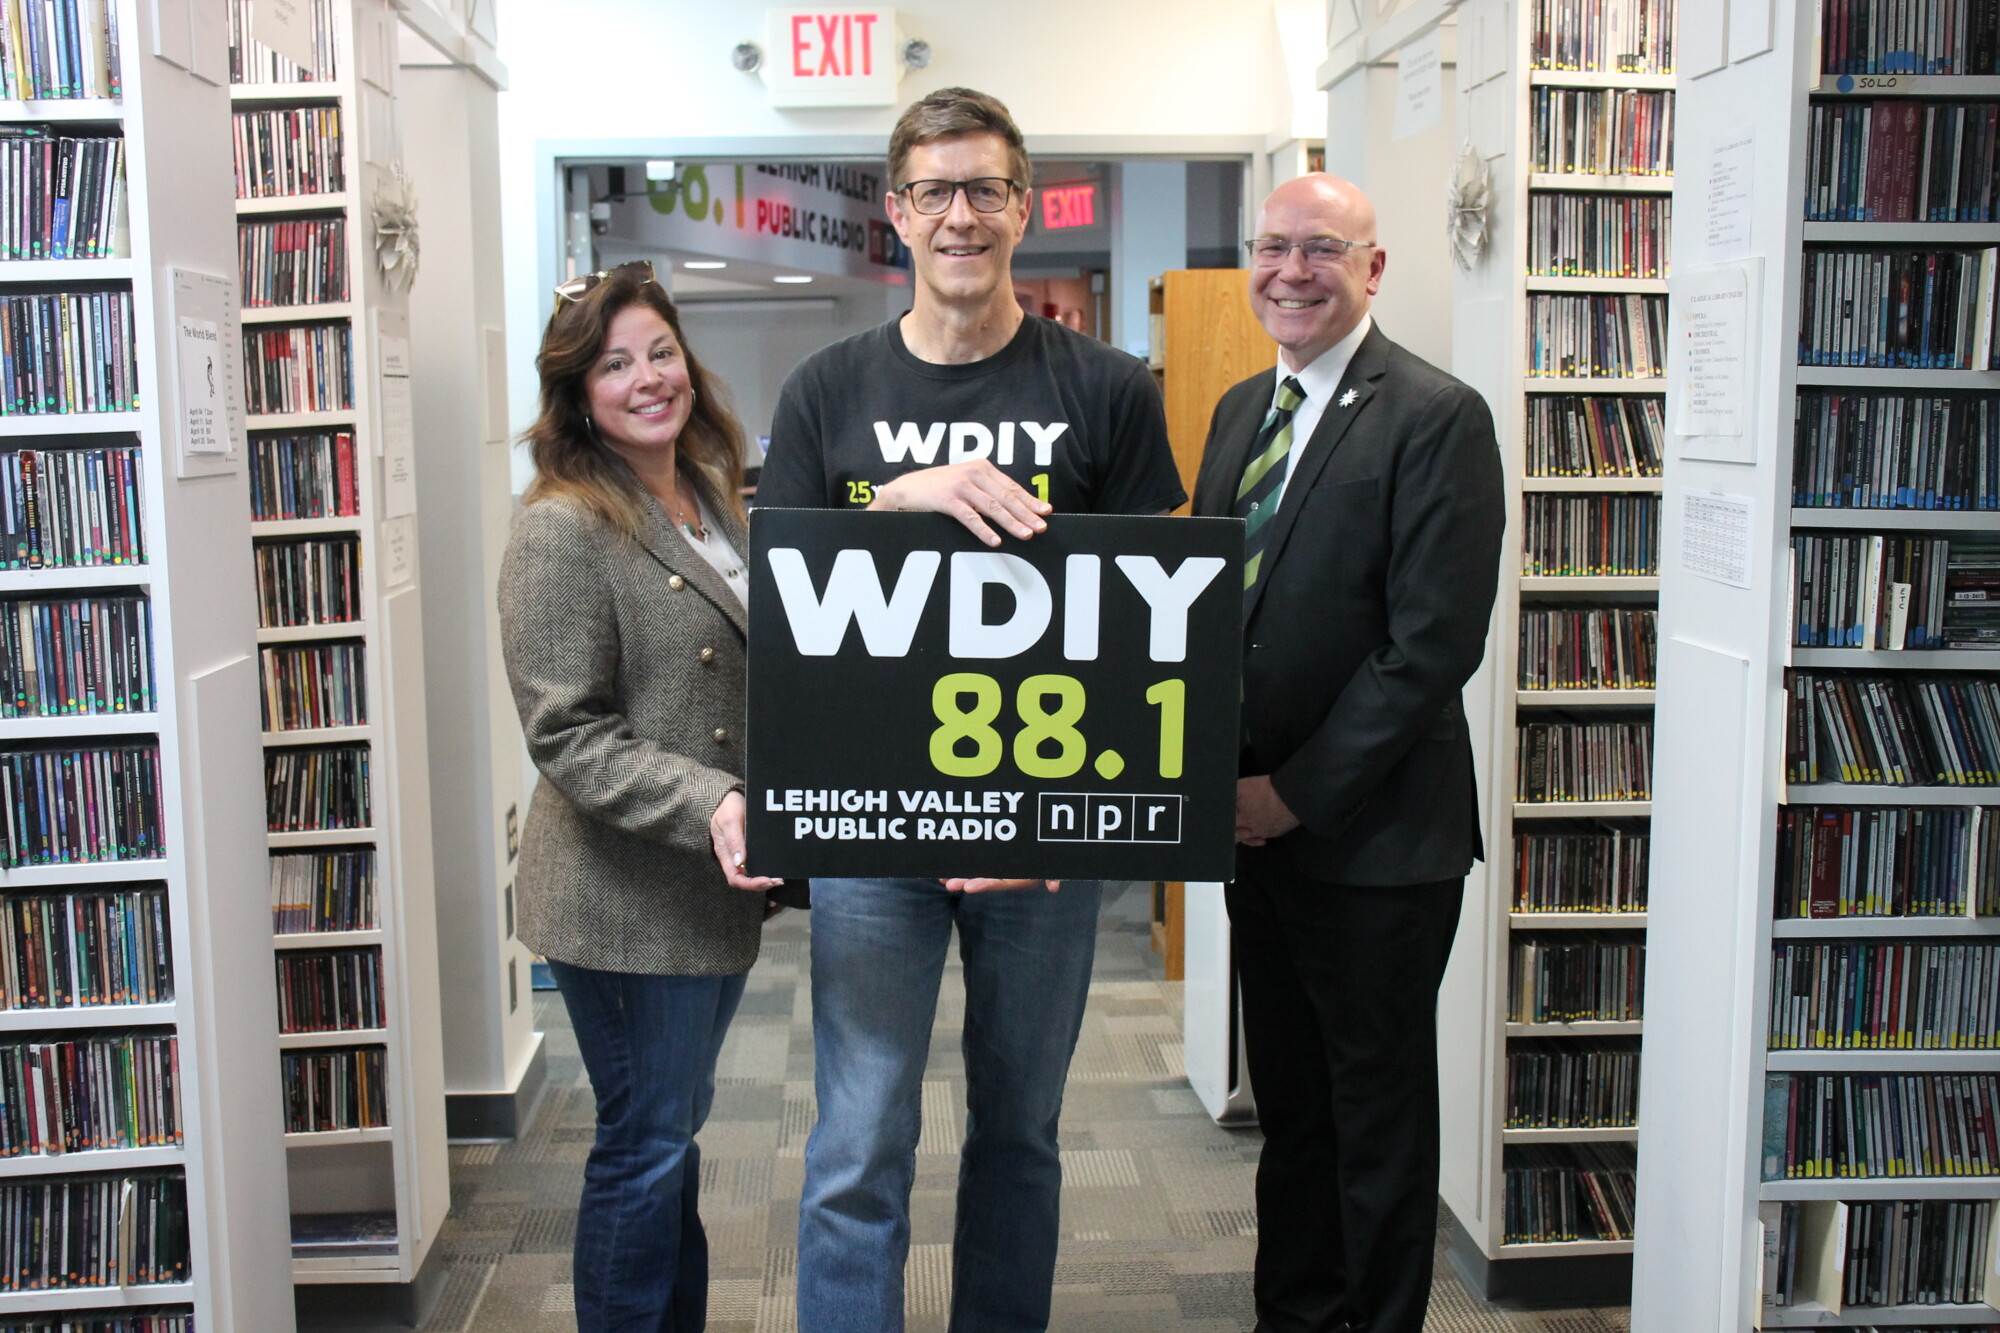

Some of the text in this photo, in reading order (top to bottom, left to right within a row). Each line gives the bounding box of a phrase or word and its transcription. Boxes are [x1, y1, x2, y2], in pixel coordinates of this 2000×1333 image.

[792, 14, 878, 77] EXIT
[1859, 77, 1896, 88] SOLO
[824, 164, 879, 203] VALLEY
[758, 199, 864, 252] PUBLIC RADIO
[1042, 186, 1095, 229] EXIT
[183, 325, 192, 337] The
[192, 327, 205, 339] World
[873, 421, 1068, 466] WDIY
[768, 548, 1226, 662] WDIY
[929, 673, 1186, 780] 88.1
[767, 790, 1024, 814] LEHIGH VALLEY
[1051, 802, 1165, 838] npr
[794, 817, 1016, 841] PUBLIC RADIO
